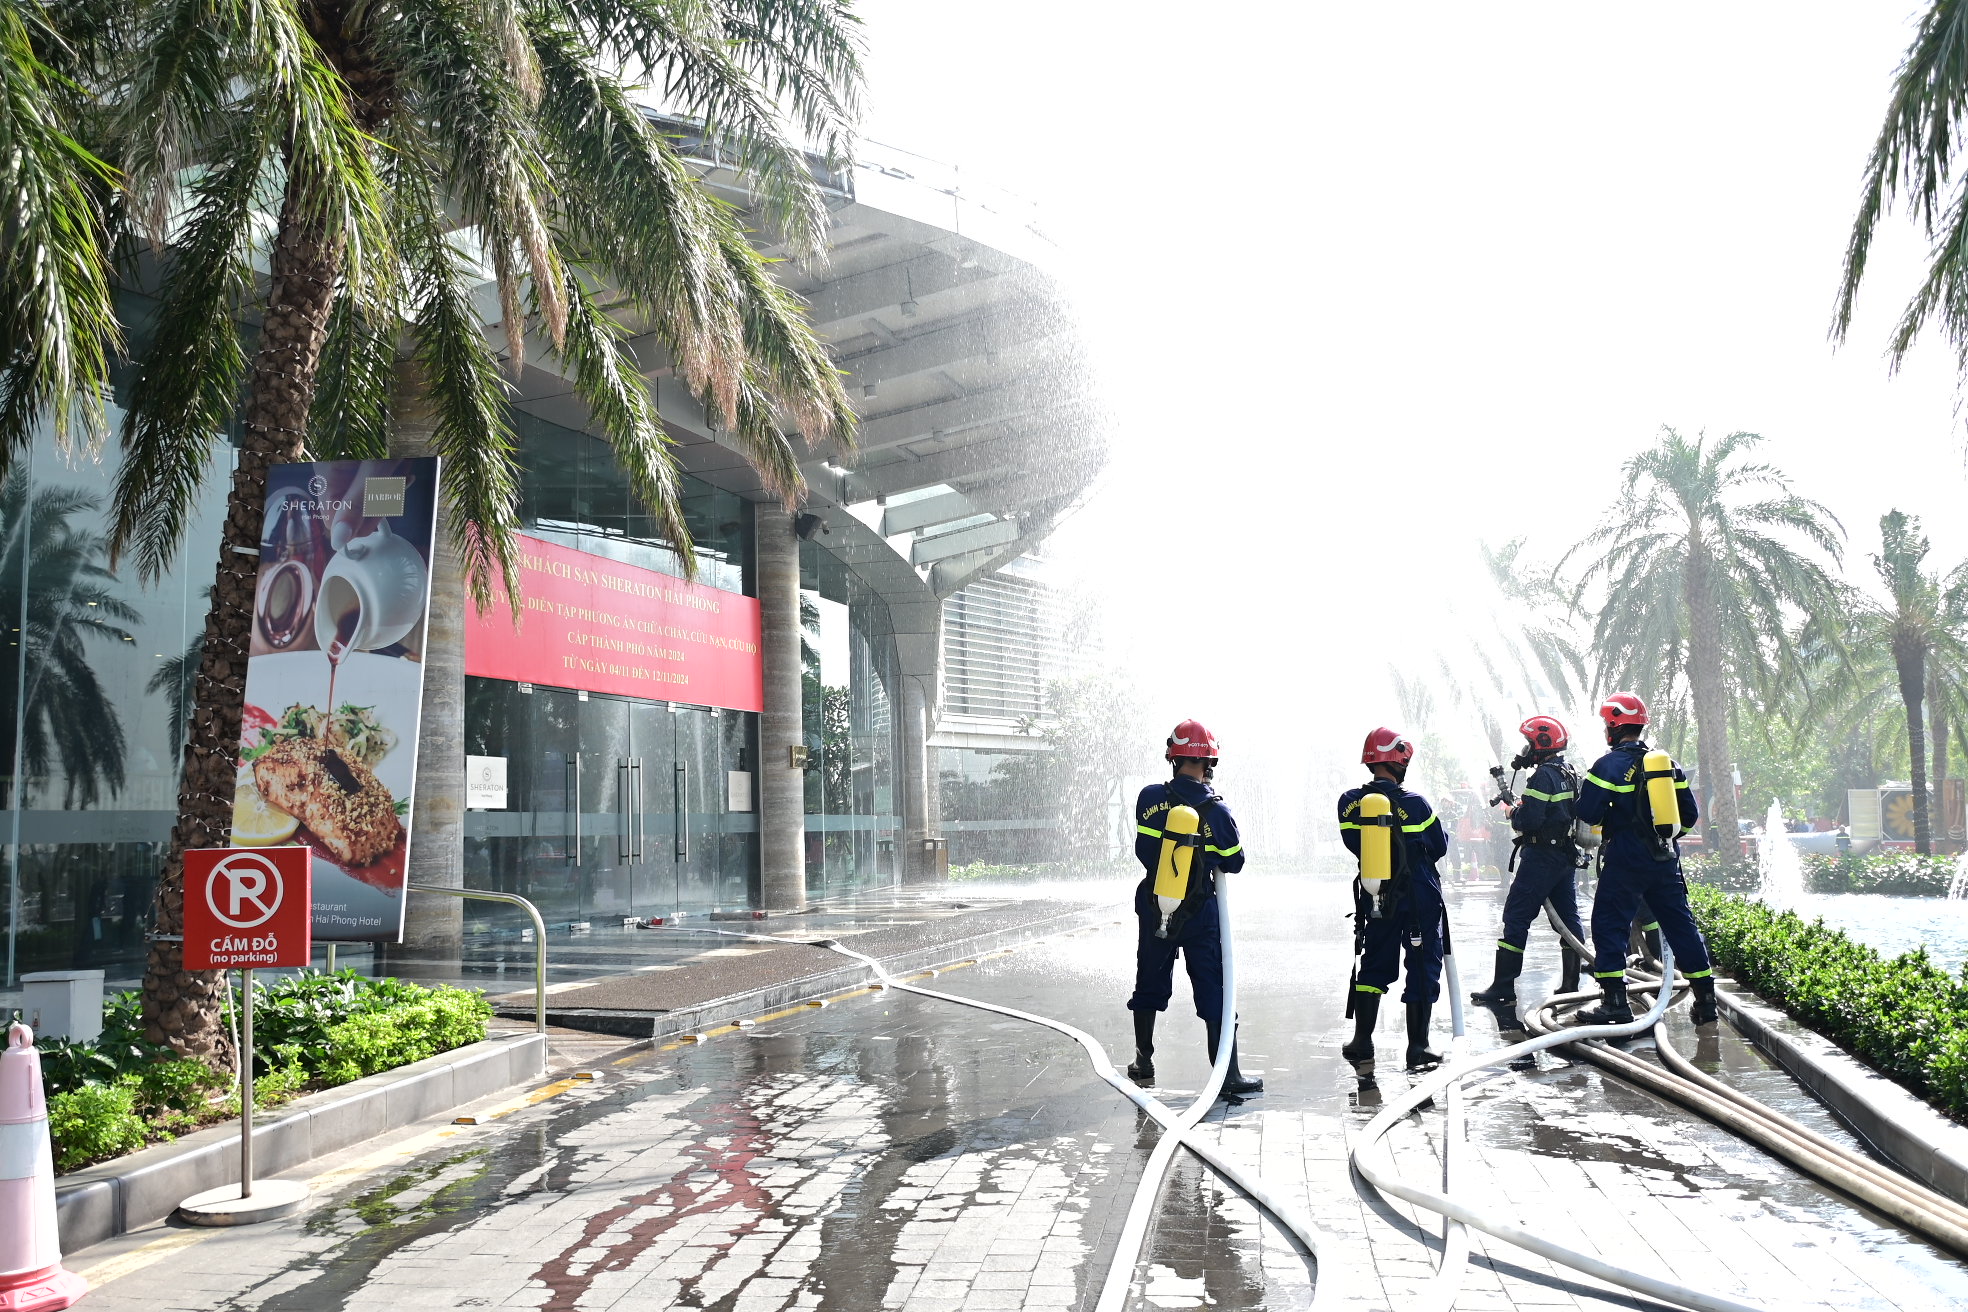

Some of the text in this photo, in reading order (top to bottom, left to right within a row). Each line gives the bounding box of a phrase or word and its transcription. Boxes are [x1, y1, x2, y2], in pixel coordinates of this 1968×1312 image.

[368, 493, 401, 501] HARBOR
[281, 500, 352, 512] SHERATON
[523, 553, 571, 579] KHÁCH
[574, 567, 598, 586] SẠN
[601, 574, 662, 601] SHERATON
[668, 649, 685, 662] 2024
[580, 657, 608, 674] NGÀY
[609, 663, 629, 677] 04/11
[653, 670, 689, 685] 12/11/2024
[470, 783, 504, 792] SHERATON
[310, 902, 347, 912] staurant
[315, 914, 330, 924] Hai
[331, 914, 358, 927] Phong
[359, 916, 382, 926] Hotel
[210, 932, 278, 952] CẤM ĐỖ
[210, 951, 278, 964] (no parking)
